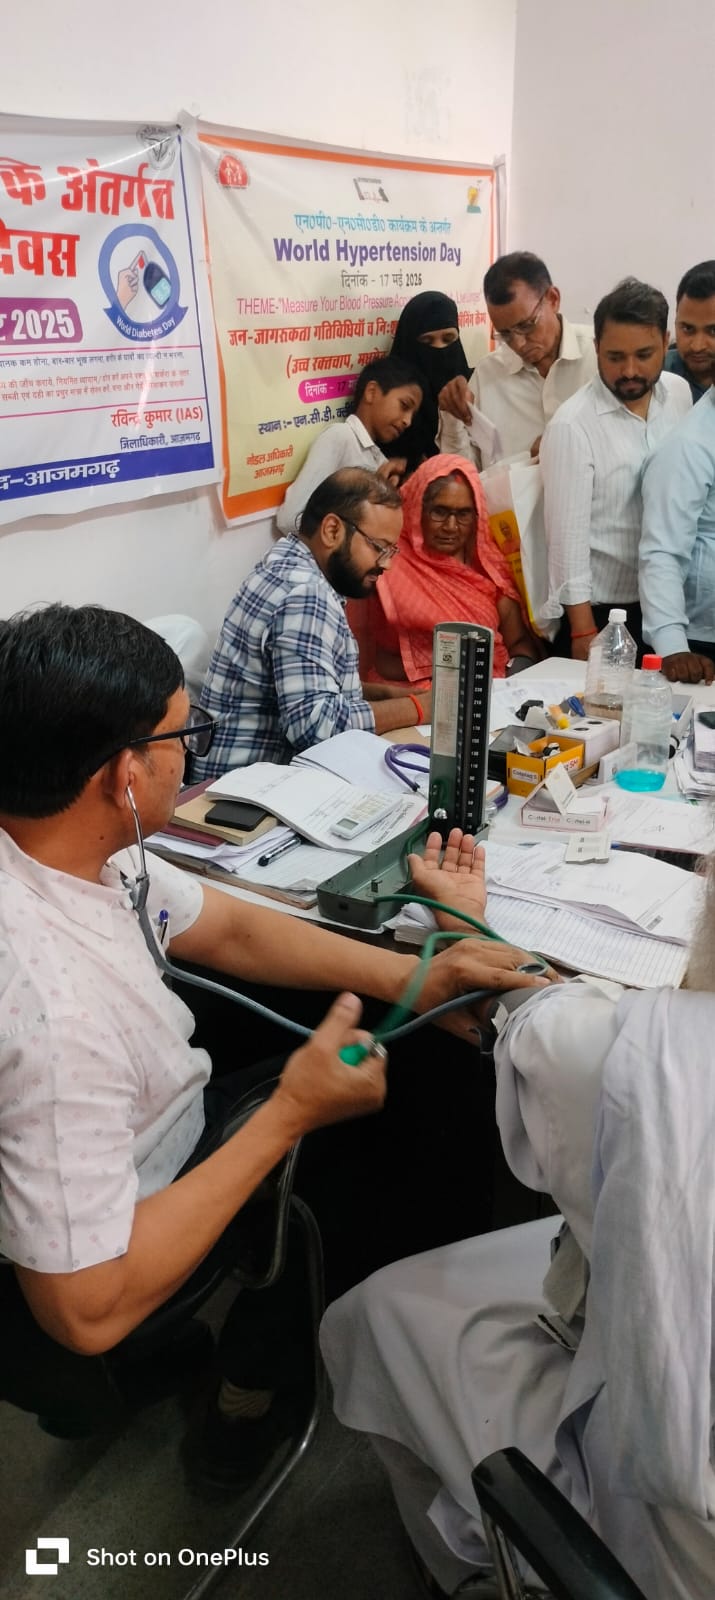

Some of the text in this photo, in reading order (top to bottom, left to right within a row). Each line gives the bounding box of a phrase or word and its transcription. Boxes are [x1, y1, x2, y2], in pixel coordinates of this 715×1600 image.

[57, 158, 175, 220] अंतर्गत
[273, 238, 462, 267] World Hypertension Day
[341, 269, 369, 289] दिनांक
[379, 273, 390, 288] 17
[391, 268, 404, 288] मई
[319, 295, 338, 312] Your
[339, 295, 361, 311] Blood
[363, 294, 395, 310] Pressure
[11, 309, 75, 340] 2025
[117, 315, 176, 338] World Diabetes Day
[366, 321, 374, 337] व
[312, 353, 354, 371] रक्तचाप,
[304, 380, 328, 398] दिनांक
[144, 409, 172, 429] कुमार
[175, 406, 204, 424] (IAS)
[258, 420, 282, 435] स्थान
